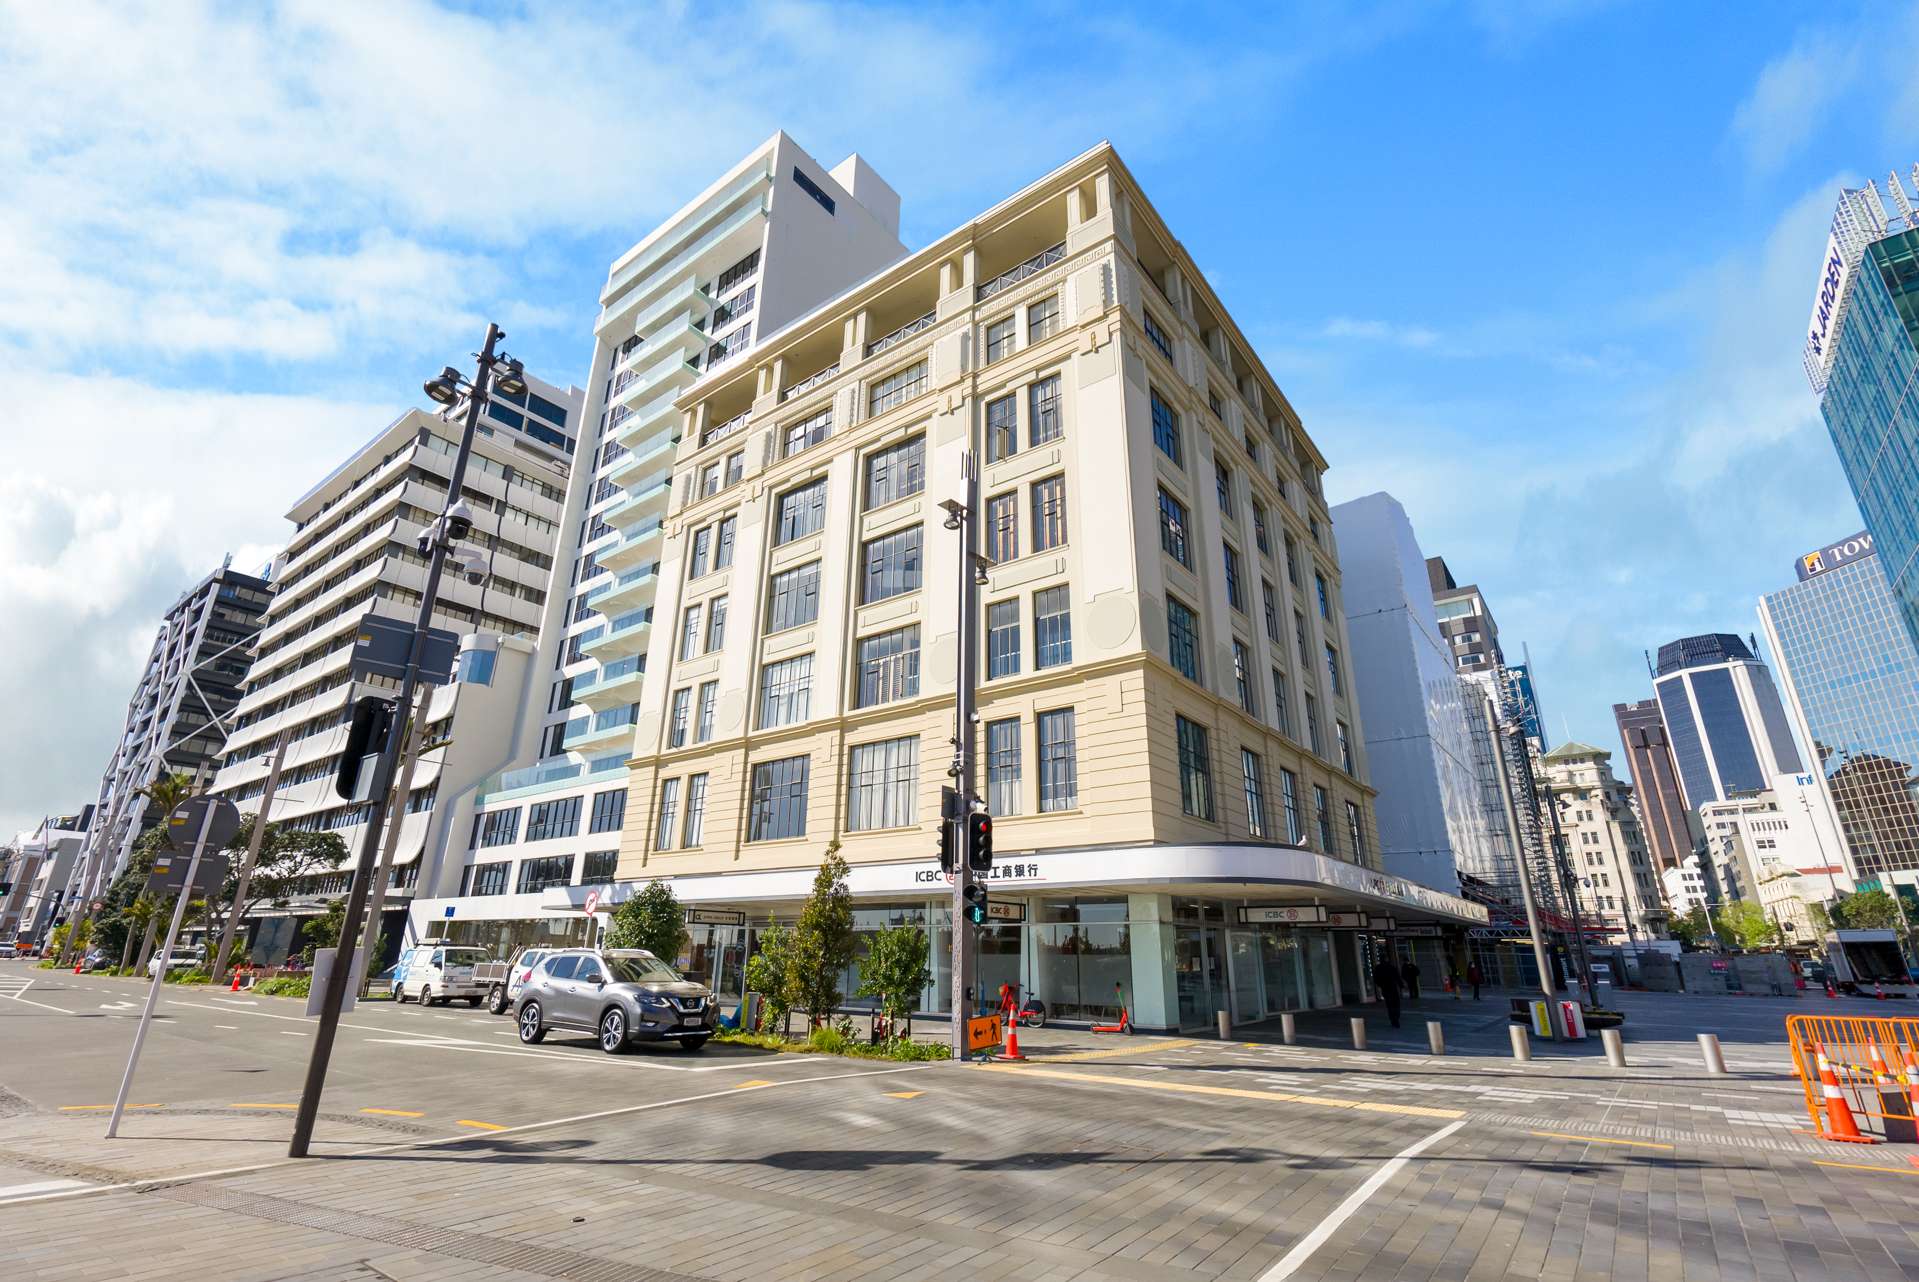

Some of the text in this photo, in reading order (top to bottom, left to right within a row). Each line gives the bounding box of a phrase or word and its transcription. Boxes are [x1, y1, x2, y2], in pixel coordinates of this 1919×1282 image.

[1817, 246, 1844, 338] JARDEN
[915, 870, 942, 882] ICBC
[973, 863, 1039, 880] 国工商银行
[1264, 911, 1285, 919] ICBC
